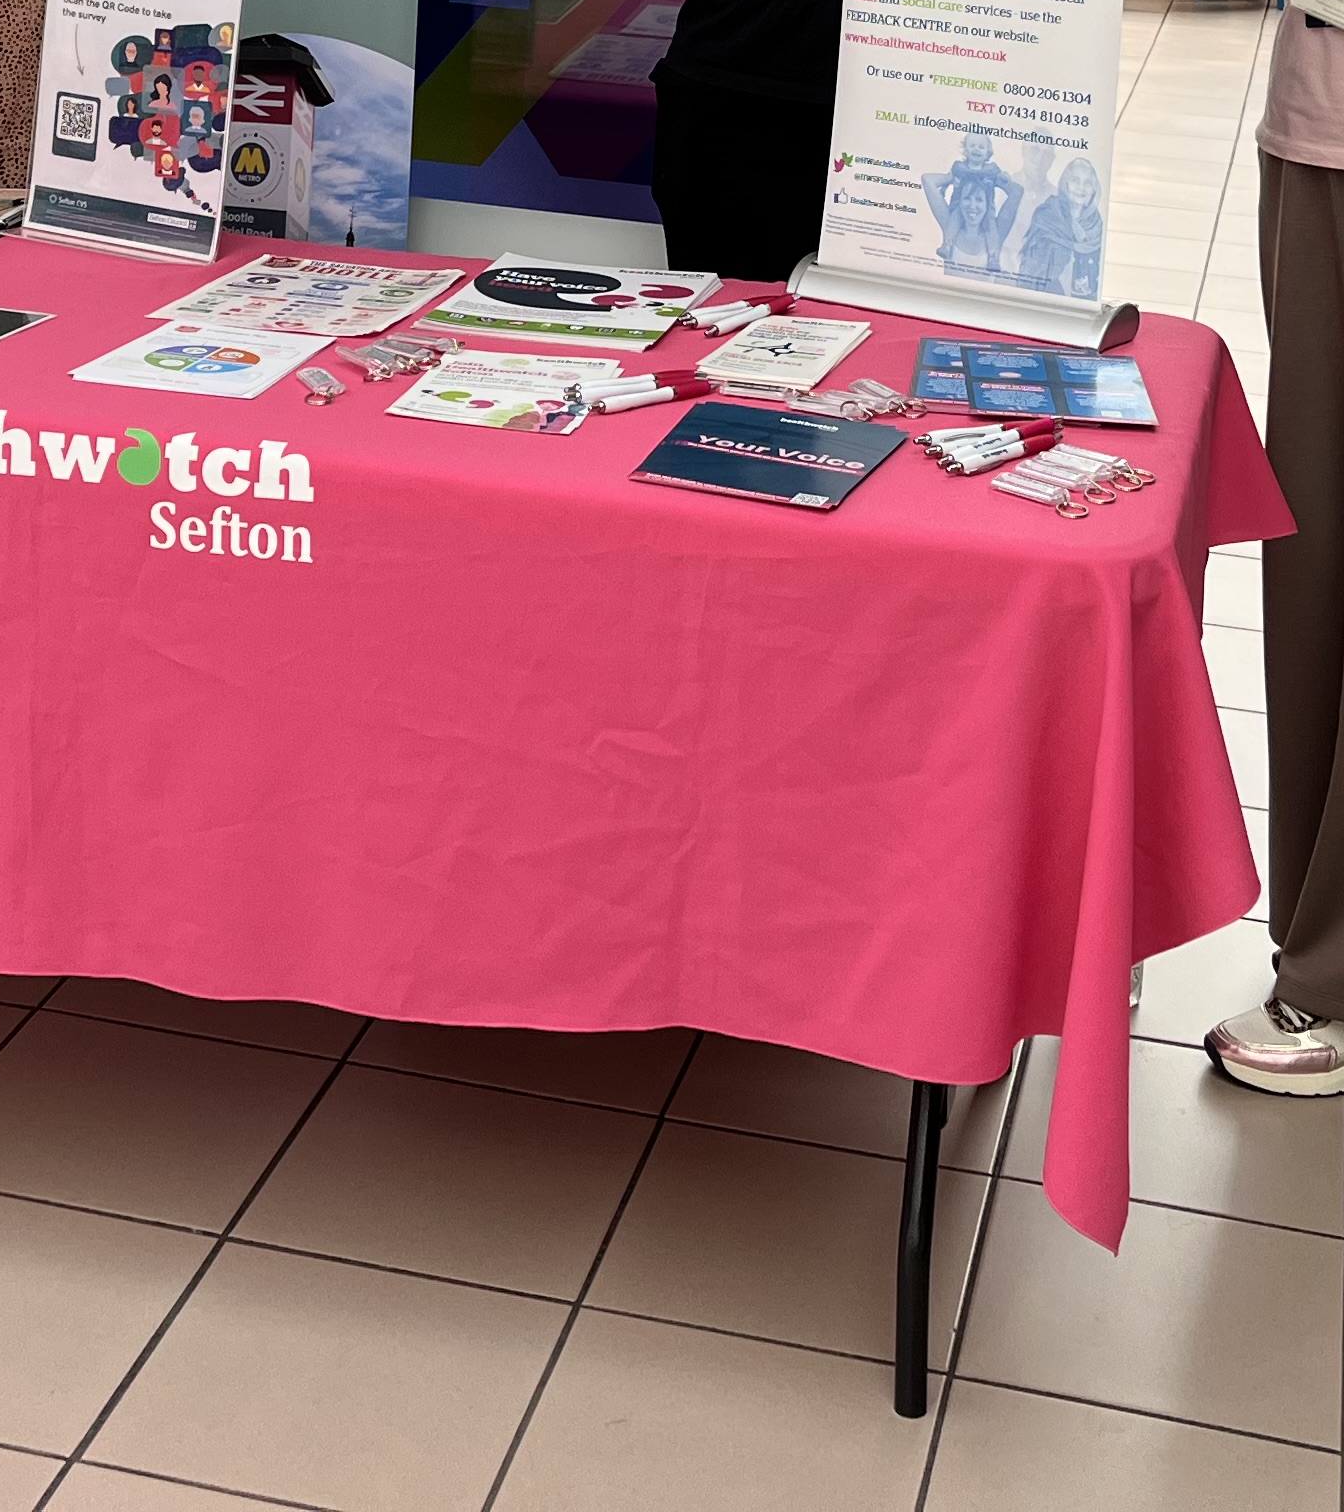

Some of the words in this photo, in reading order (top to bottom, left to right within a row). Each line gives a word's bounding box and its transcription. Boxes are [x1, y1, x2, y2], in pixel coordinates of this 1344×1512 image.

[63, 7, 77, 17] the
[79, 10, 107, 24] survey
[102, 0, 116, 11] QR
[117, 2, 140, 15] Code
[142, 6, 151, 16] to
[152, 8, 172, 20] take
[938, 0, 963, 12] care
[965, 2, 1013, 18] services
[1020, 10, 1041, 22] use
[1042, 12, 1062, 25] the
[846, 9, 901, 28] FEEDBACK
[903, 17, 952, 33] CENTRE
[953, 23, 969, 35] on
[971, 25, 992, 38] our
[993, 27, 1039, 44] website:
[844, 32, 1007, 62] www.healthwatchsefton.co.uk
[866, 65, 881, 77] Or
[882, 68, 902, 80] use
[904, 71, 925, 83] our
[1003, 82, 1035, 99] 0800
[1037, 86, 1060, 101] 206
[1062, 90, 1092, 105] 1304
[967, 101, 996, 115] TEXT
[998, 104, 1036, 121] 07434
[1040, 110, 1090, 128] 810438
[875, 110, 910, 125] EMAIL
[913, 114, 1089, 150] info@healthwatchsefton.co.uk
[493, 275, 551, 289] your
[549, 281, 608, 292] voice
[500, 269, 557, 282] Have
[698, 434, 771, 454] Your
[776, 448, 866, 470] Voice
[149, 502, 314, 564] Sefton
